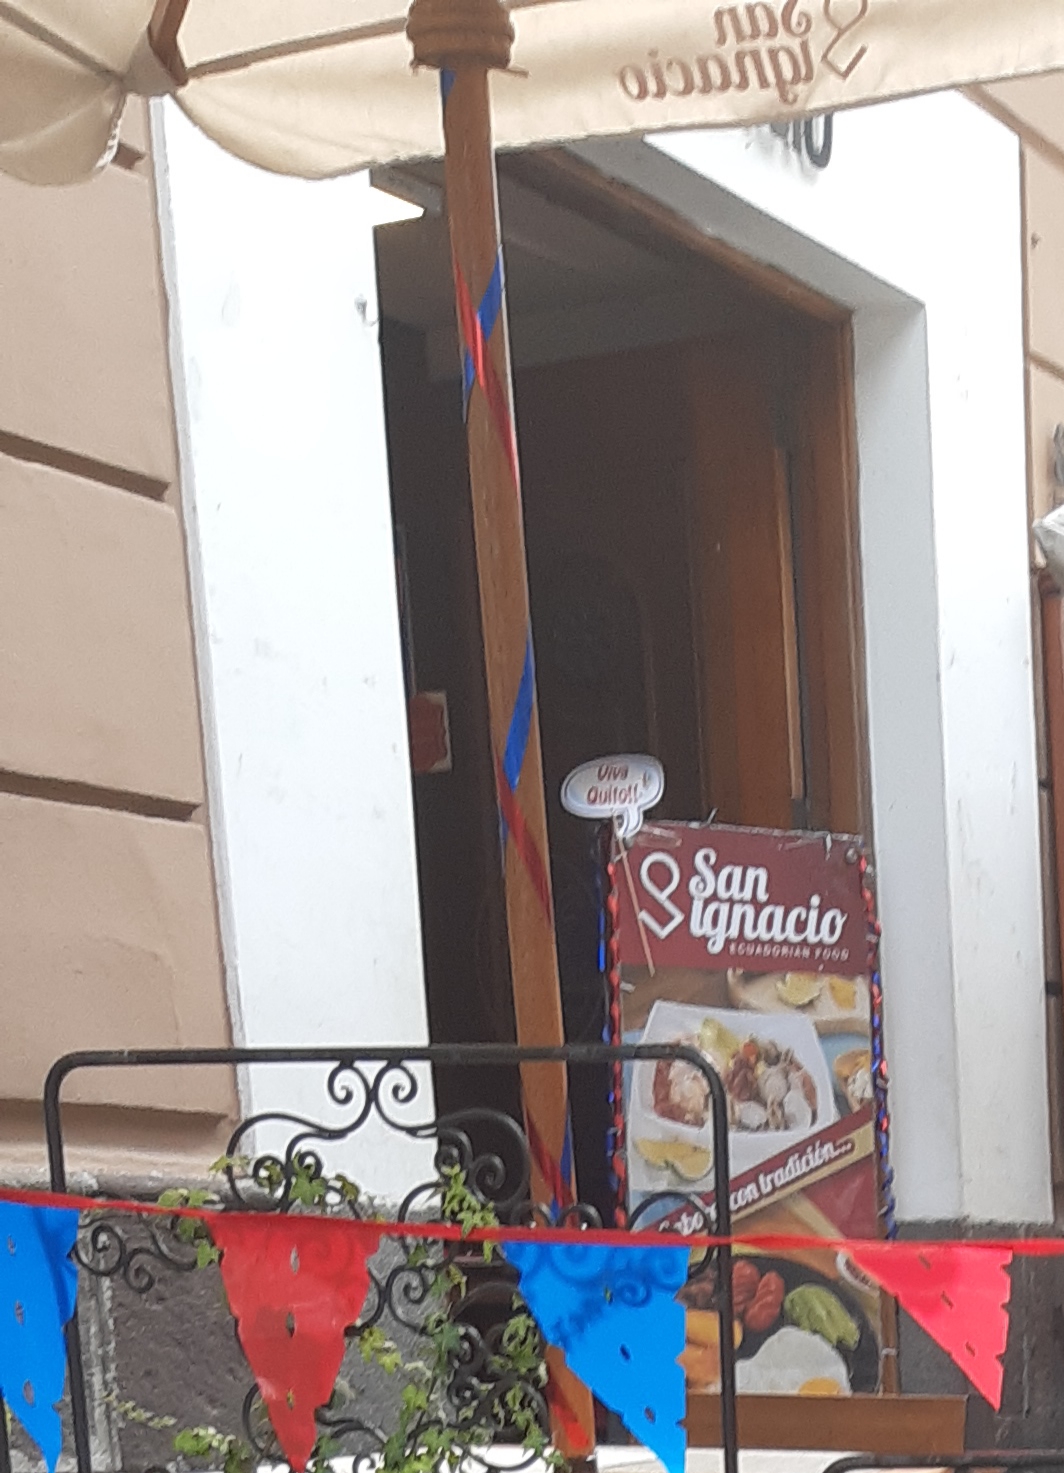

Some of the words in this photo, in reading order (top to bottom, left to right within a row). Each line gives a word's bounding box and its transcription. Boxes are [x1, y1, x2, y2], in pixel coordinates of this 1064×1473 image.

[689, 847, 769, 904] San
[689, 893, 847, 954] Ignacio
[729, 942, 811, 959] ECUADORIAN
[814, 945, 850, 962] FOOD
